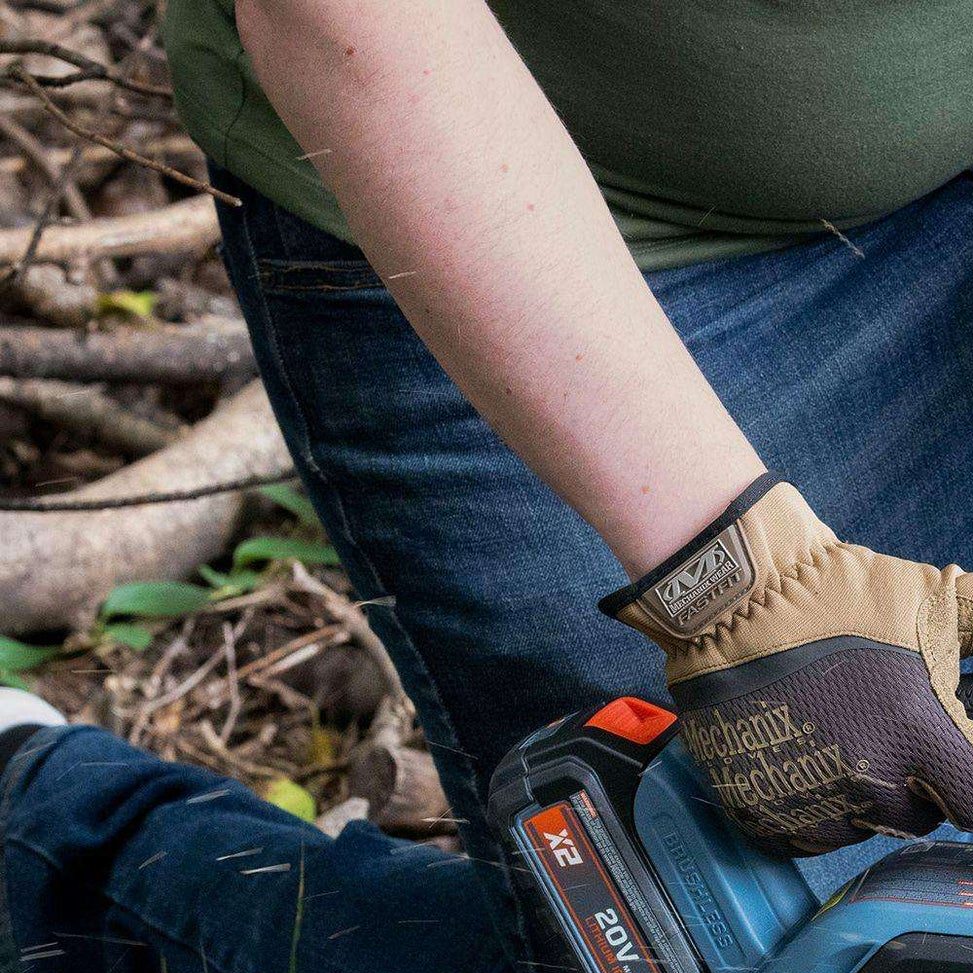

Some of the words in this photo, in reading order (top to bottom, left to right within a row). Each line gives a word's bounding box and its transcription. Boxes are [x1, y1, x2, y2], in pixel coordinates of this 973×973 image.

[678, 571, 741, 625] FASTFIT
[709, 561, 734, 584] WEAR
[544, 829, 583, 867] X2
[663, 831, 733, 947] BRUSHLESS
[585, 915, 616, 964] LITHIUM
[595, 908, 639, 961] 20V
